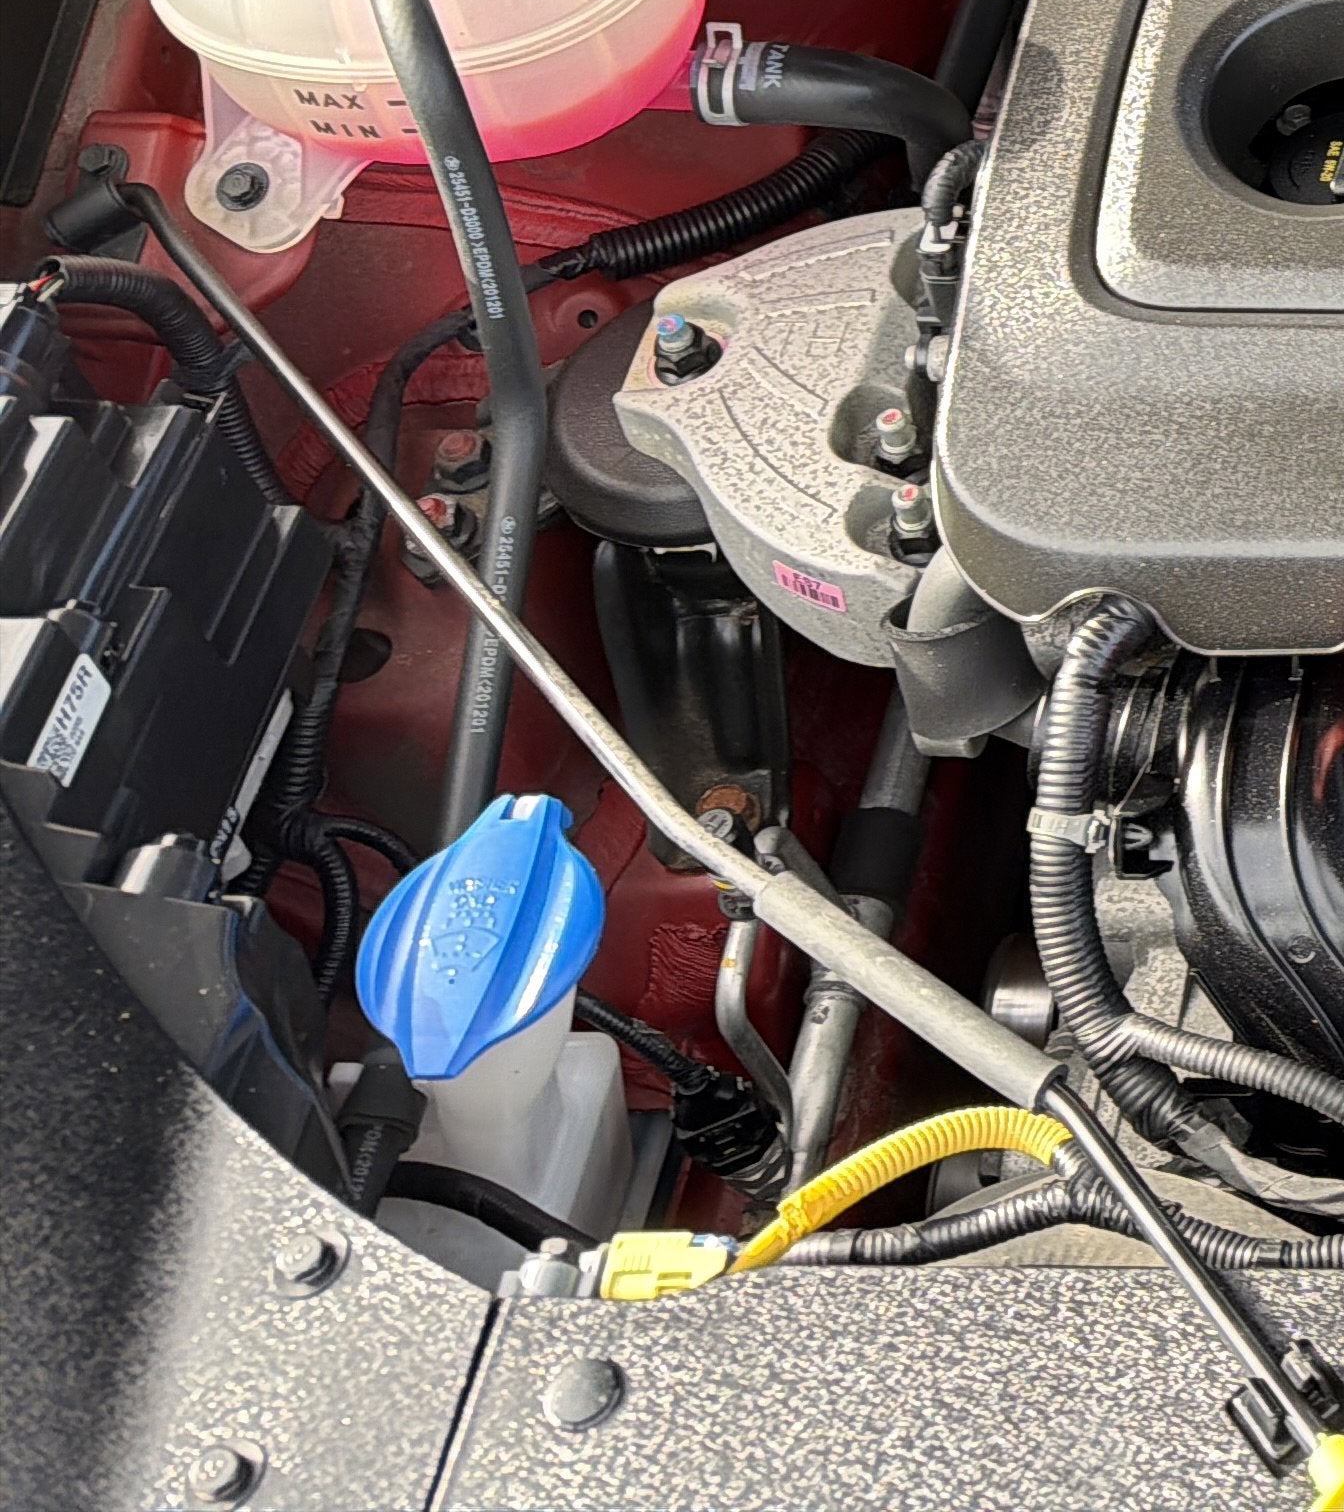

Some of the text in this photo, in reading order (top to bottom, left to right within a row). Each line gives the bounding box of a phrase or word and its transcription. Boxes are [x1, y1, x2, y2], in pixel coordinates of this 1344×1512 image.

[763, 44, 790, 88] TANK
[294, 89, 364, 110] MAX
[310, 120, 382, 138] MIN
[1327, 141, 1344, 157] SAE
[448, 171, 486, 239] 25451-D3000
